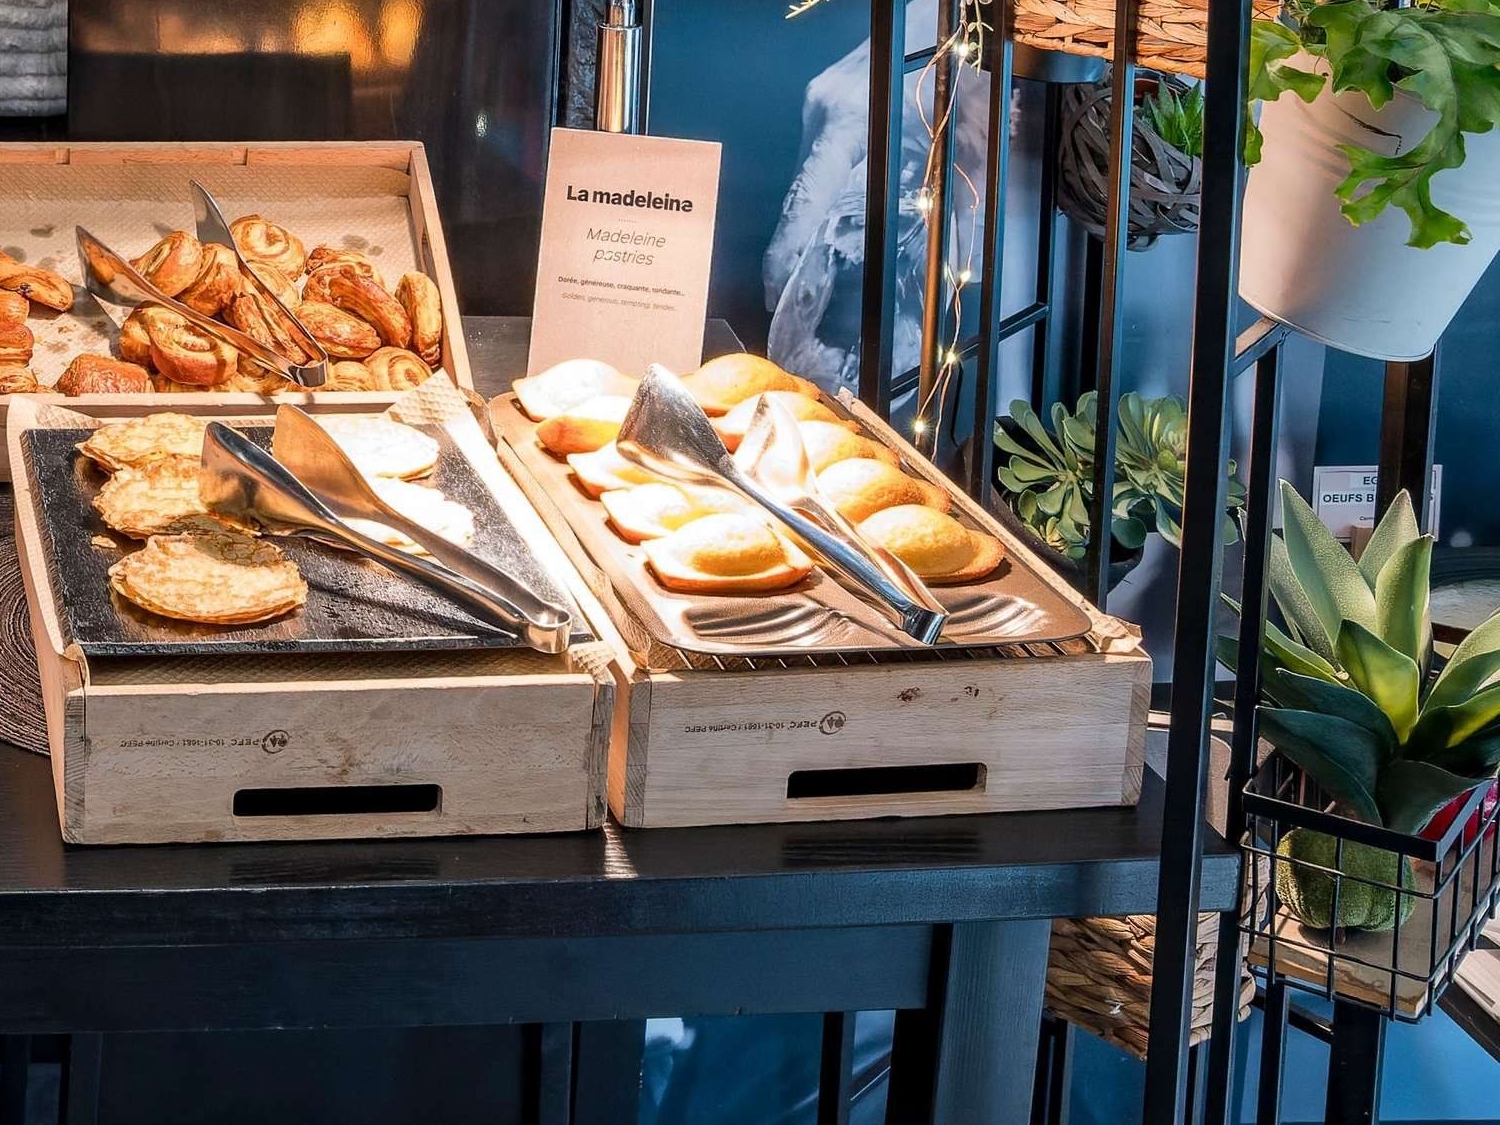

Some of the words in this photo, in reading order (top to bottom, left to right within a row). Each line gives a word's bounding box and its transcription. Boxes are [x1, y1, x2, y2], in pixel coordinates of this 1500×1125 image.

[567, 185, 589, 203] La
[586, 227, 667, 248] Madeleine
[593, 247, 655, 266] pastries
[1323, 493, 1363, 503] OEUFS
[684, 725, 707, 733] PEFC
[789, 720, 817, 729] PEFC
[229, 738, 260, 746] PEFC
